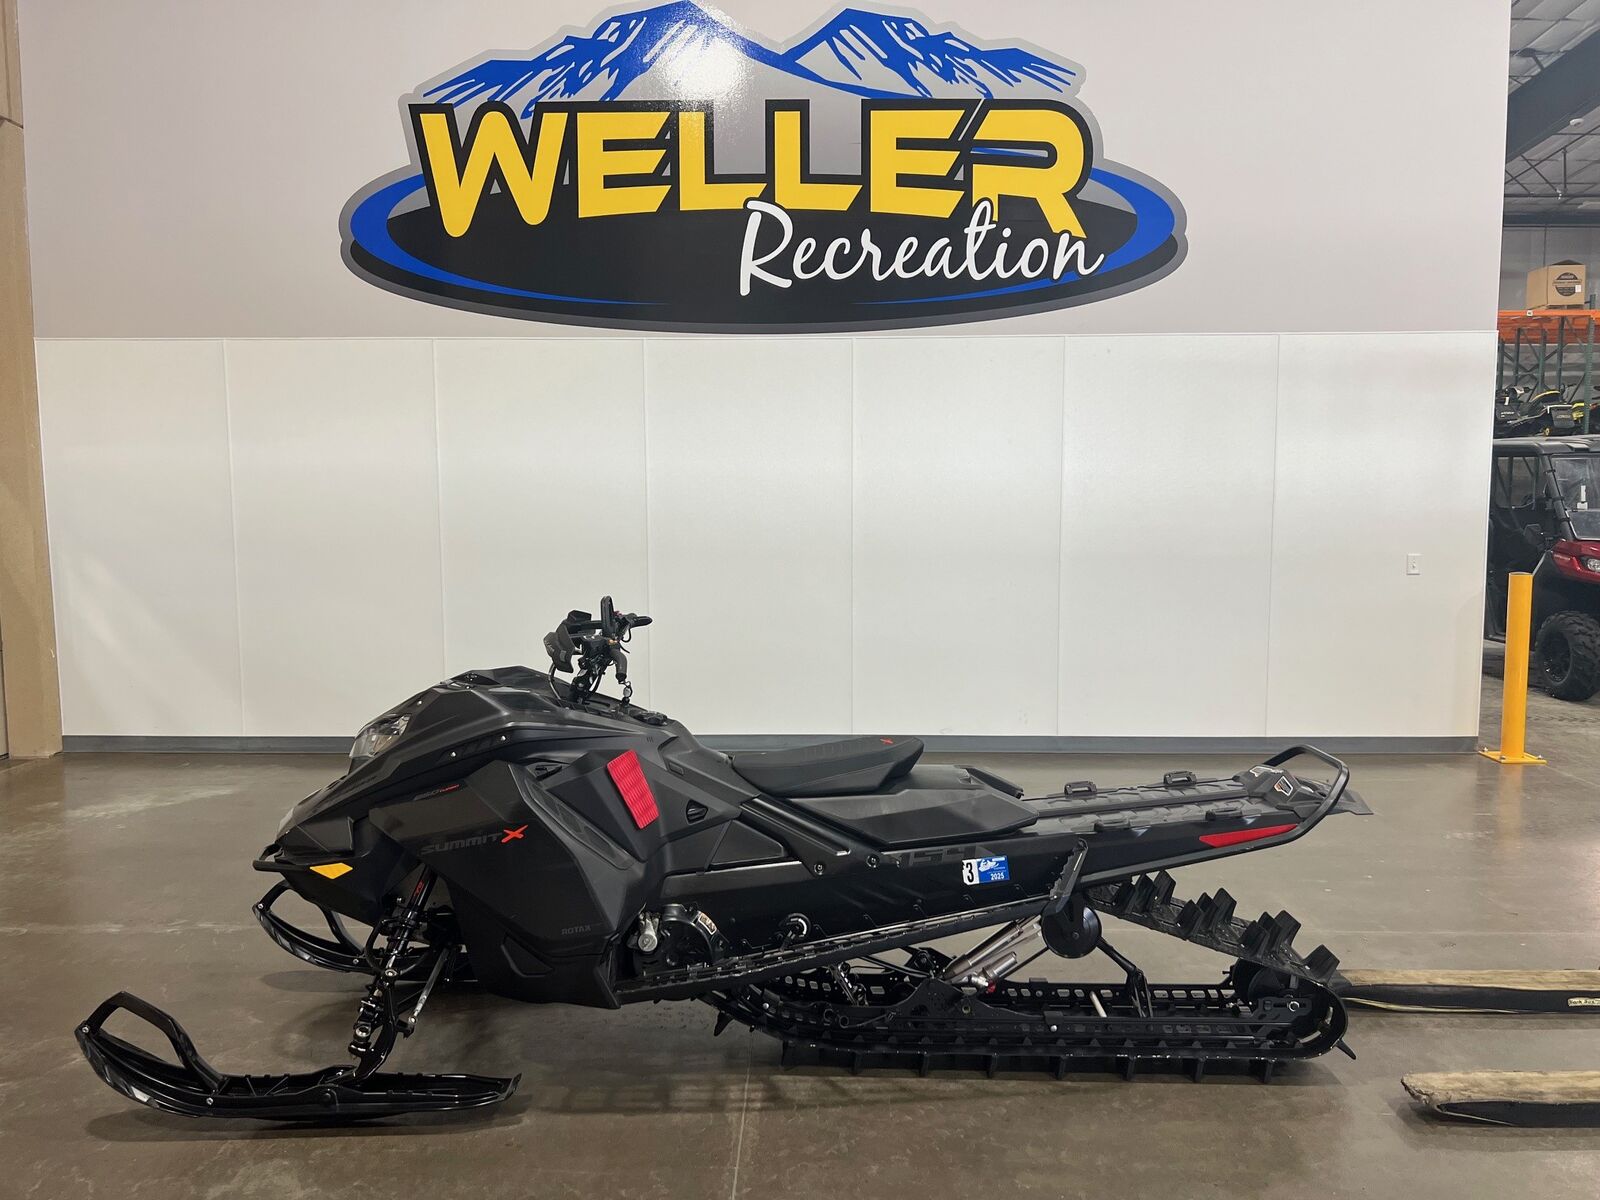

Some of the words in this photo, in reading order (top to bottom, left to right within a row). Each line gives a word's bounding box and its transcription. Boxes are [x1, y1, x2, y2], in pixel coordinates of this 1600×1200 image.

[418, 108, 1087, 239] WELLER
[739, 198, 1105, 297] Recreation
[420, 832, 501, 855] SUMMIT
[500, 824, 529, 844] X
[965, 861, 975, 883] 3
[990, 872, 1005, 881] 2025
[561, 924, 592, 935] ROTAX
